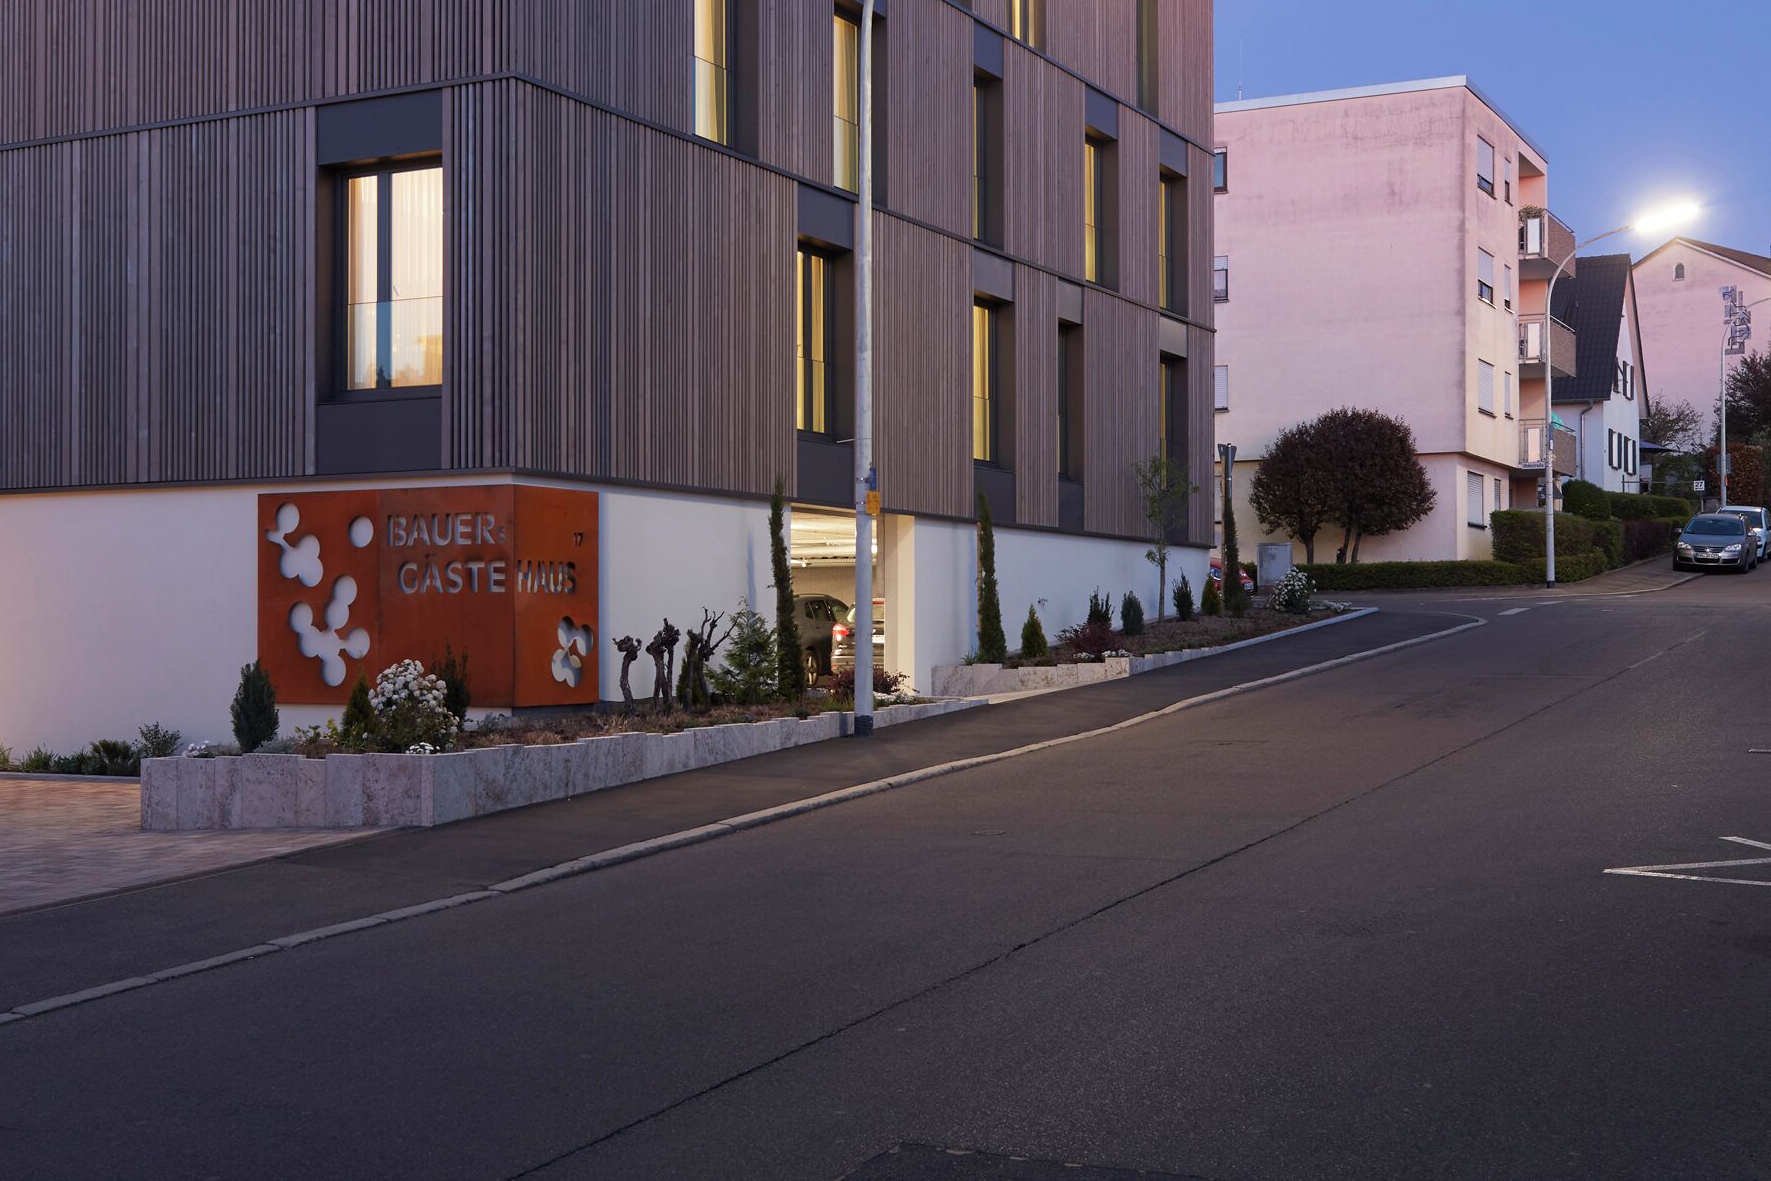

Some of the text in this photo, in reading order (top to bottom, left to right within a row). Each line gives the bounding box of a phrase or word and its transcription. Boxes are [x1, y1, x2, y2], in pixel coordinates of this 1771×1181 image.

[573, 531, 584, 547] 17
[397, 553, 577, 595] GÄSTE HAUS
